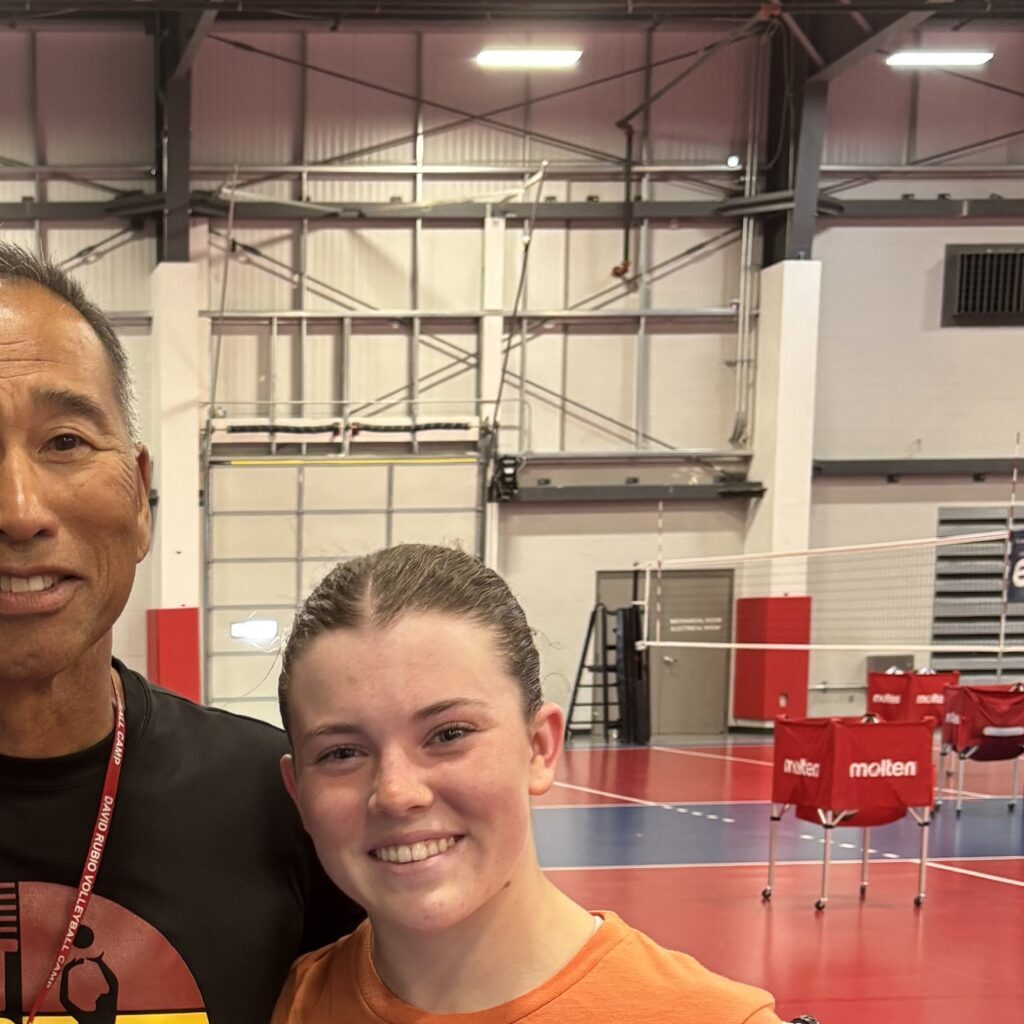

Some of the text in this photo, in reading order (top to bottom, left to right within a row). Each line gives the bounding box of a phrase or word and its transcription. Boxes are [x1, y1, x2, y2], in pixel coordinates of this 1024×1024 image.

[849, 759, 917, 778] molten
[97, 795, 114, 832] DAVID
[87, 834, 105, 872] RUBIO
[61, 874, 94, 951] VOLLEYBALL
